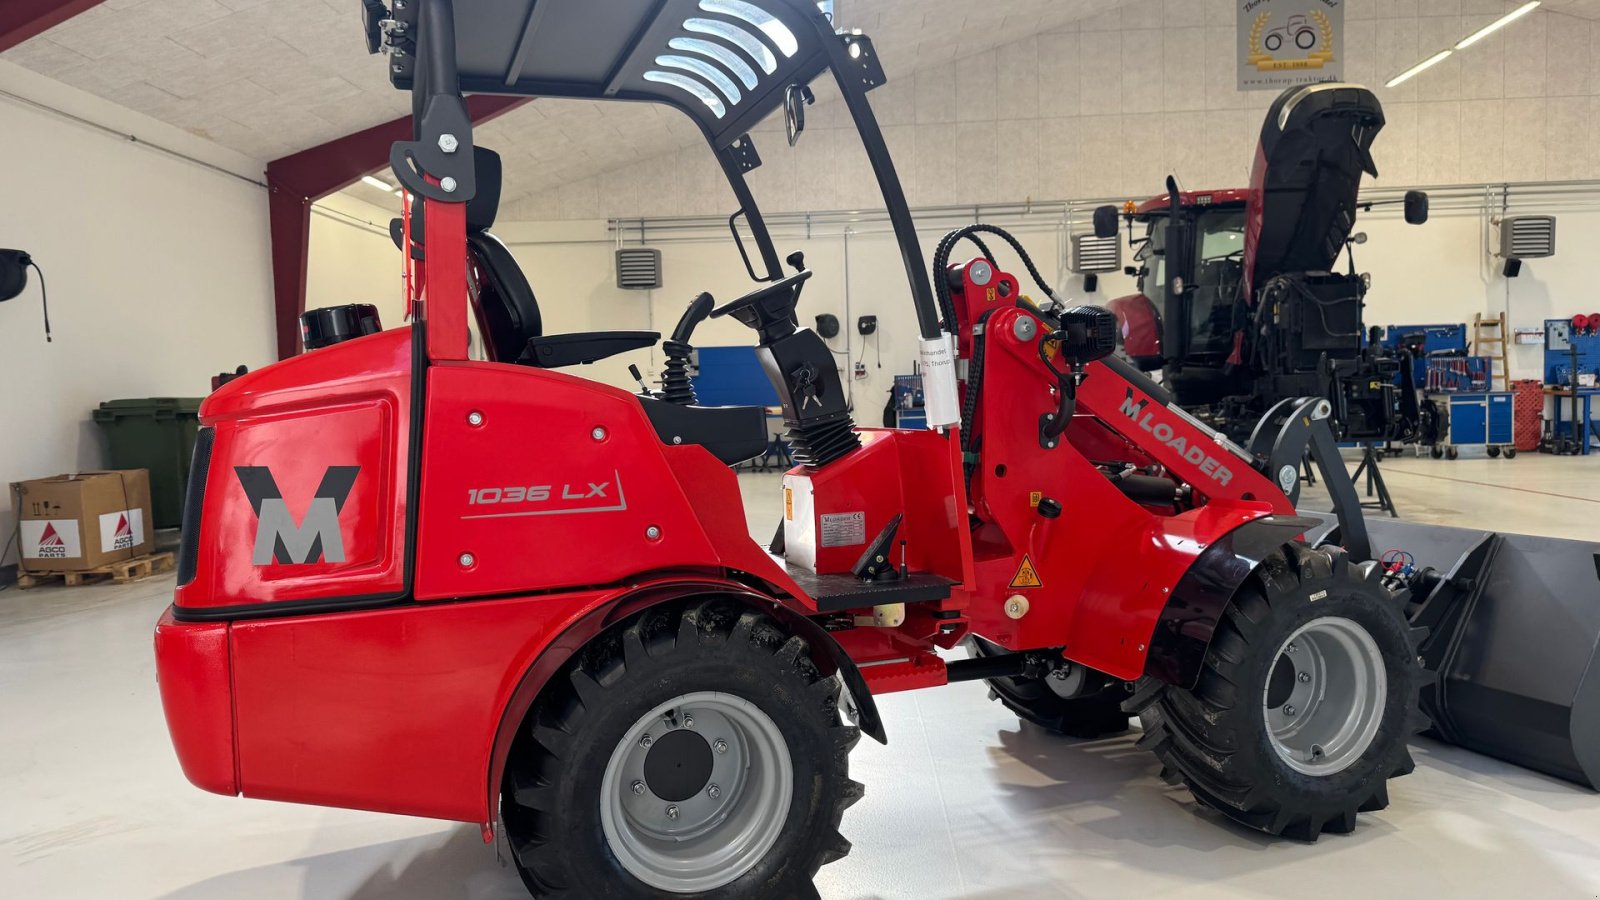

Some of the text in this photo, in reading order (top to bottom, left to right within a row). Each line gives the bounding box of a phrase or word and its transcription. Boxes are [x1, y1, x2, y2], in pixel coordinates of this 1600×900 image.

[468, 482, 609, 505] 1036 LX
[114, 536, 134, 545] AGCO
